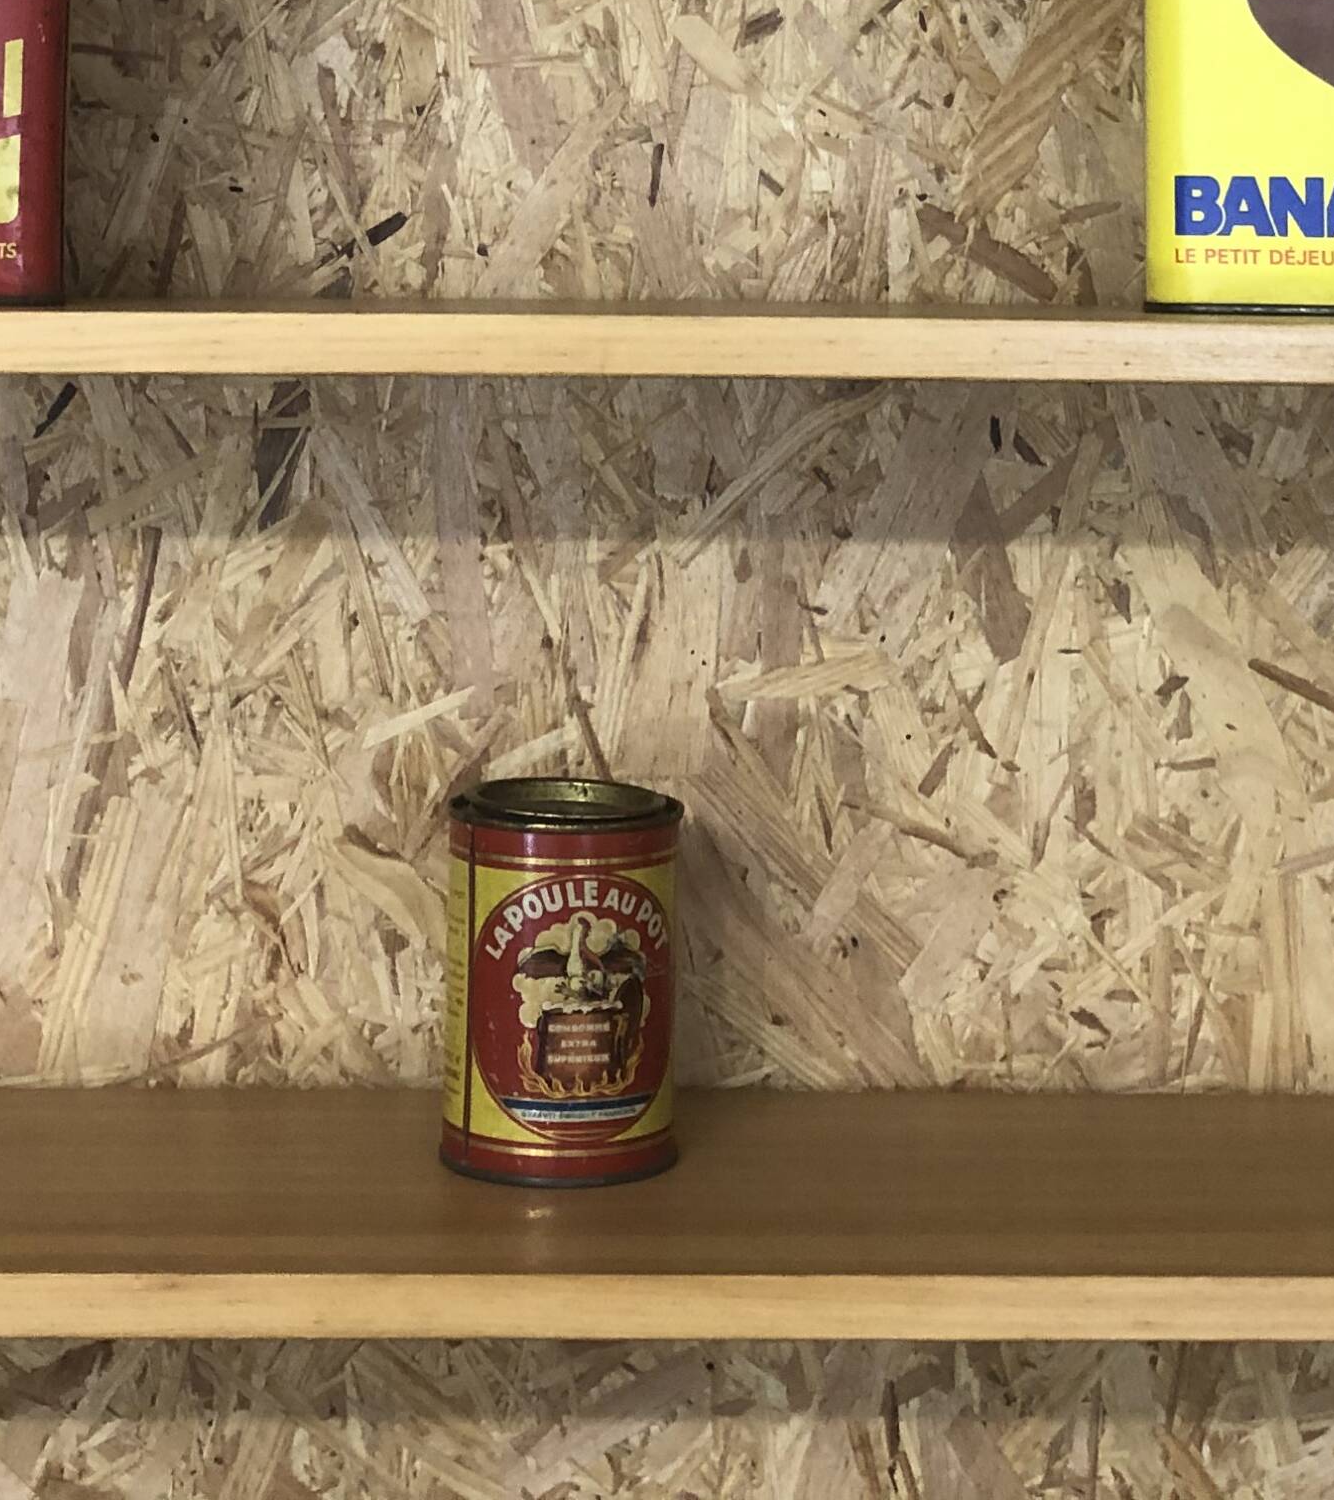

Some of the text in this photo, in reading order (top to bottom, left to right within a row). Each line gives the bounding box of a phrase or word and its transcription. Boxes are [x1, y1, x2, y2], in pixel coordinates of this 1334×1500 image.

[1175, 248, 1199, 264] LE
[1205, 248, 1259, 266] PETIT
[485, 881, 666, 960] LA POULE AU POT
